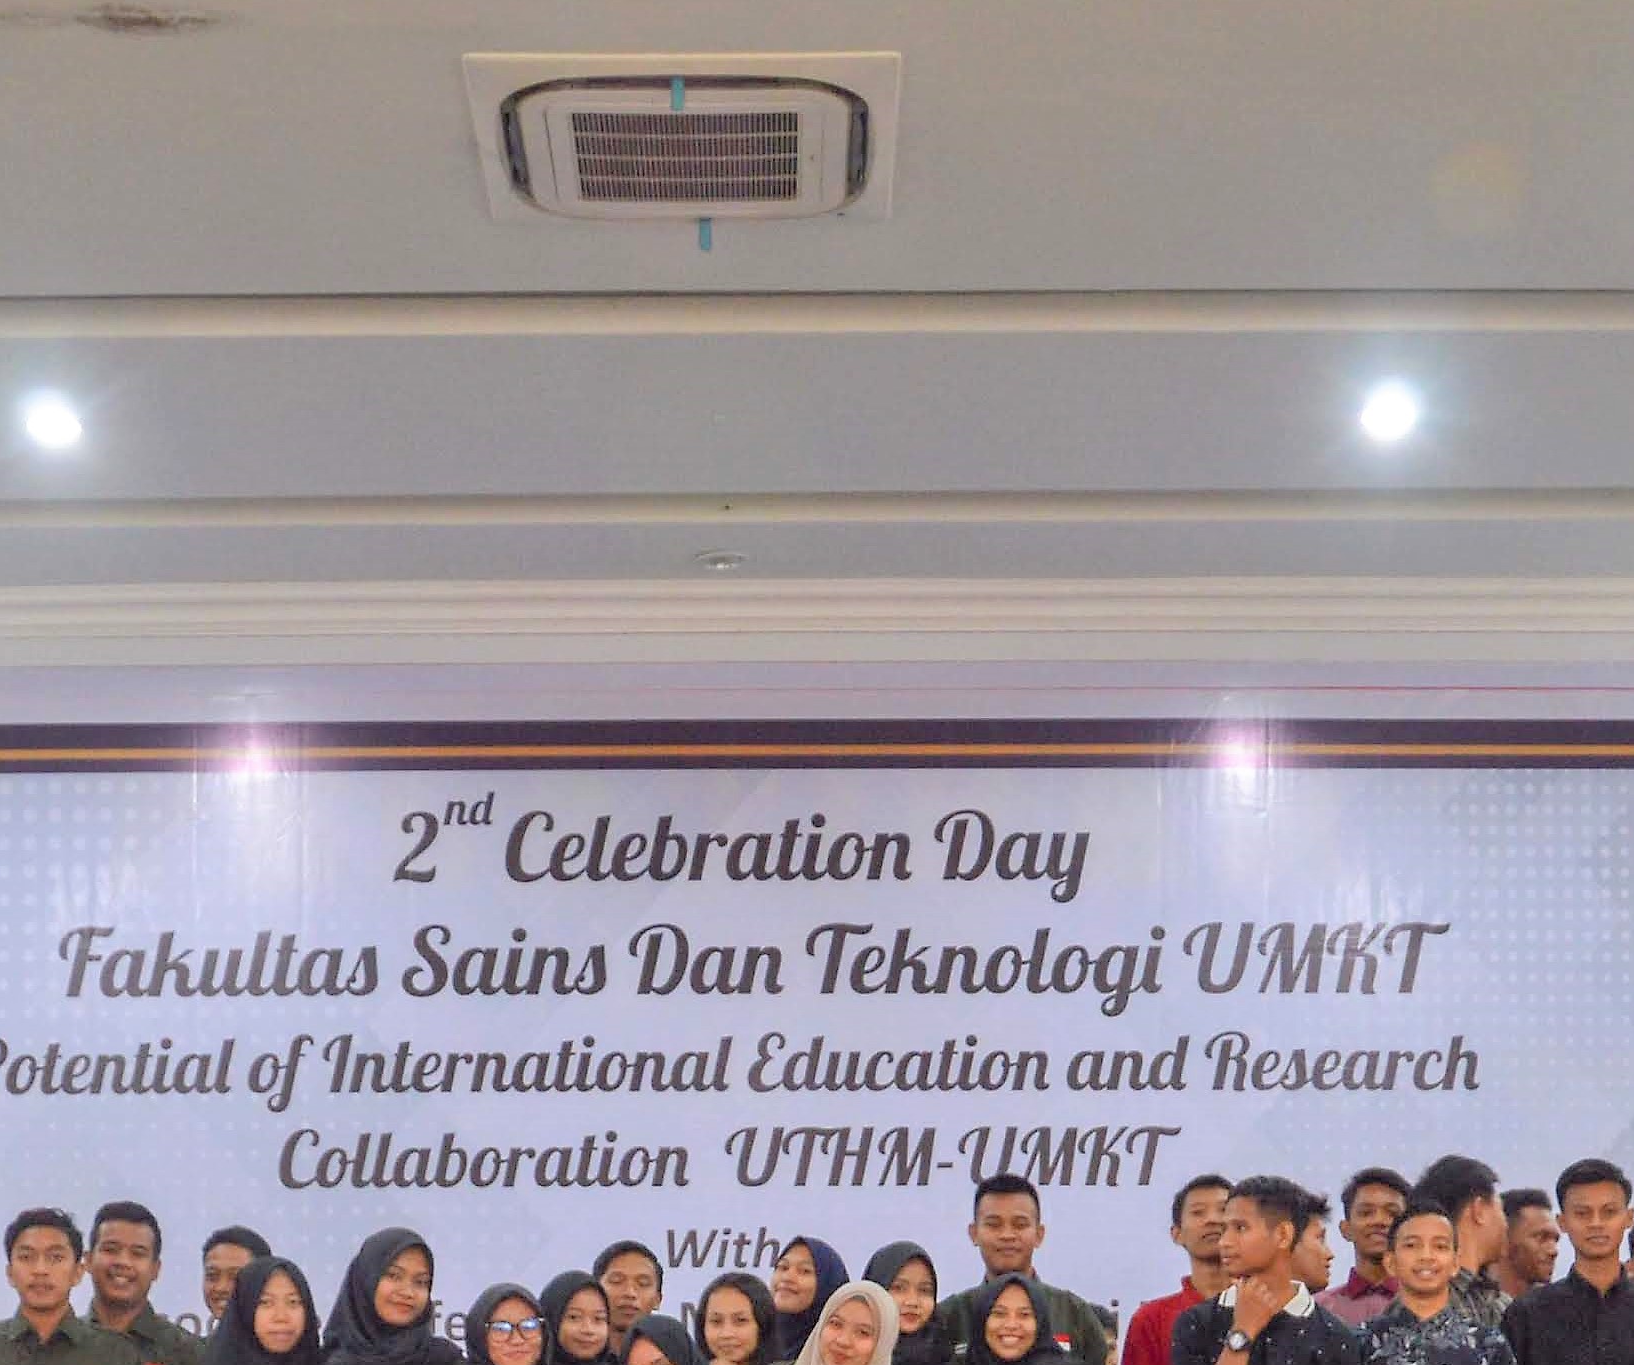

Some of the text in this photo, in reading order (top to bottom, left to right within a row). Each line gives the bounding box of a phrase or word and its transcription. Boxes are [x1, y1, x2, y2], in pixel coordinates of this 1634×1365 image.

[393, 791, 1090, 904] 2nd Celebration Day
[59, 921, 1451, 1018] Fakultas Sains Dan Teknologi UMKT
[247, 1033, 314, 1114] of
[322, 1033, 731, 1094] International
[747, 1031, 1050, 1093] Education
[1066, 1035, 1190, 1092] and
[1204, 1030, 1480, 1093] Research
[278, 1124, 1182, 1190] Collaboration UTHM-UMKT
[667, 1226, 781, 1269] With
